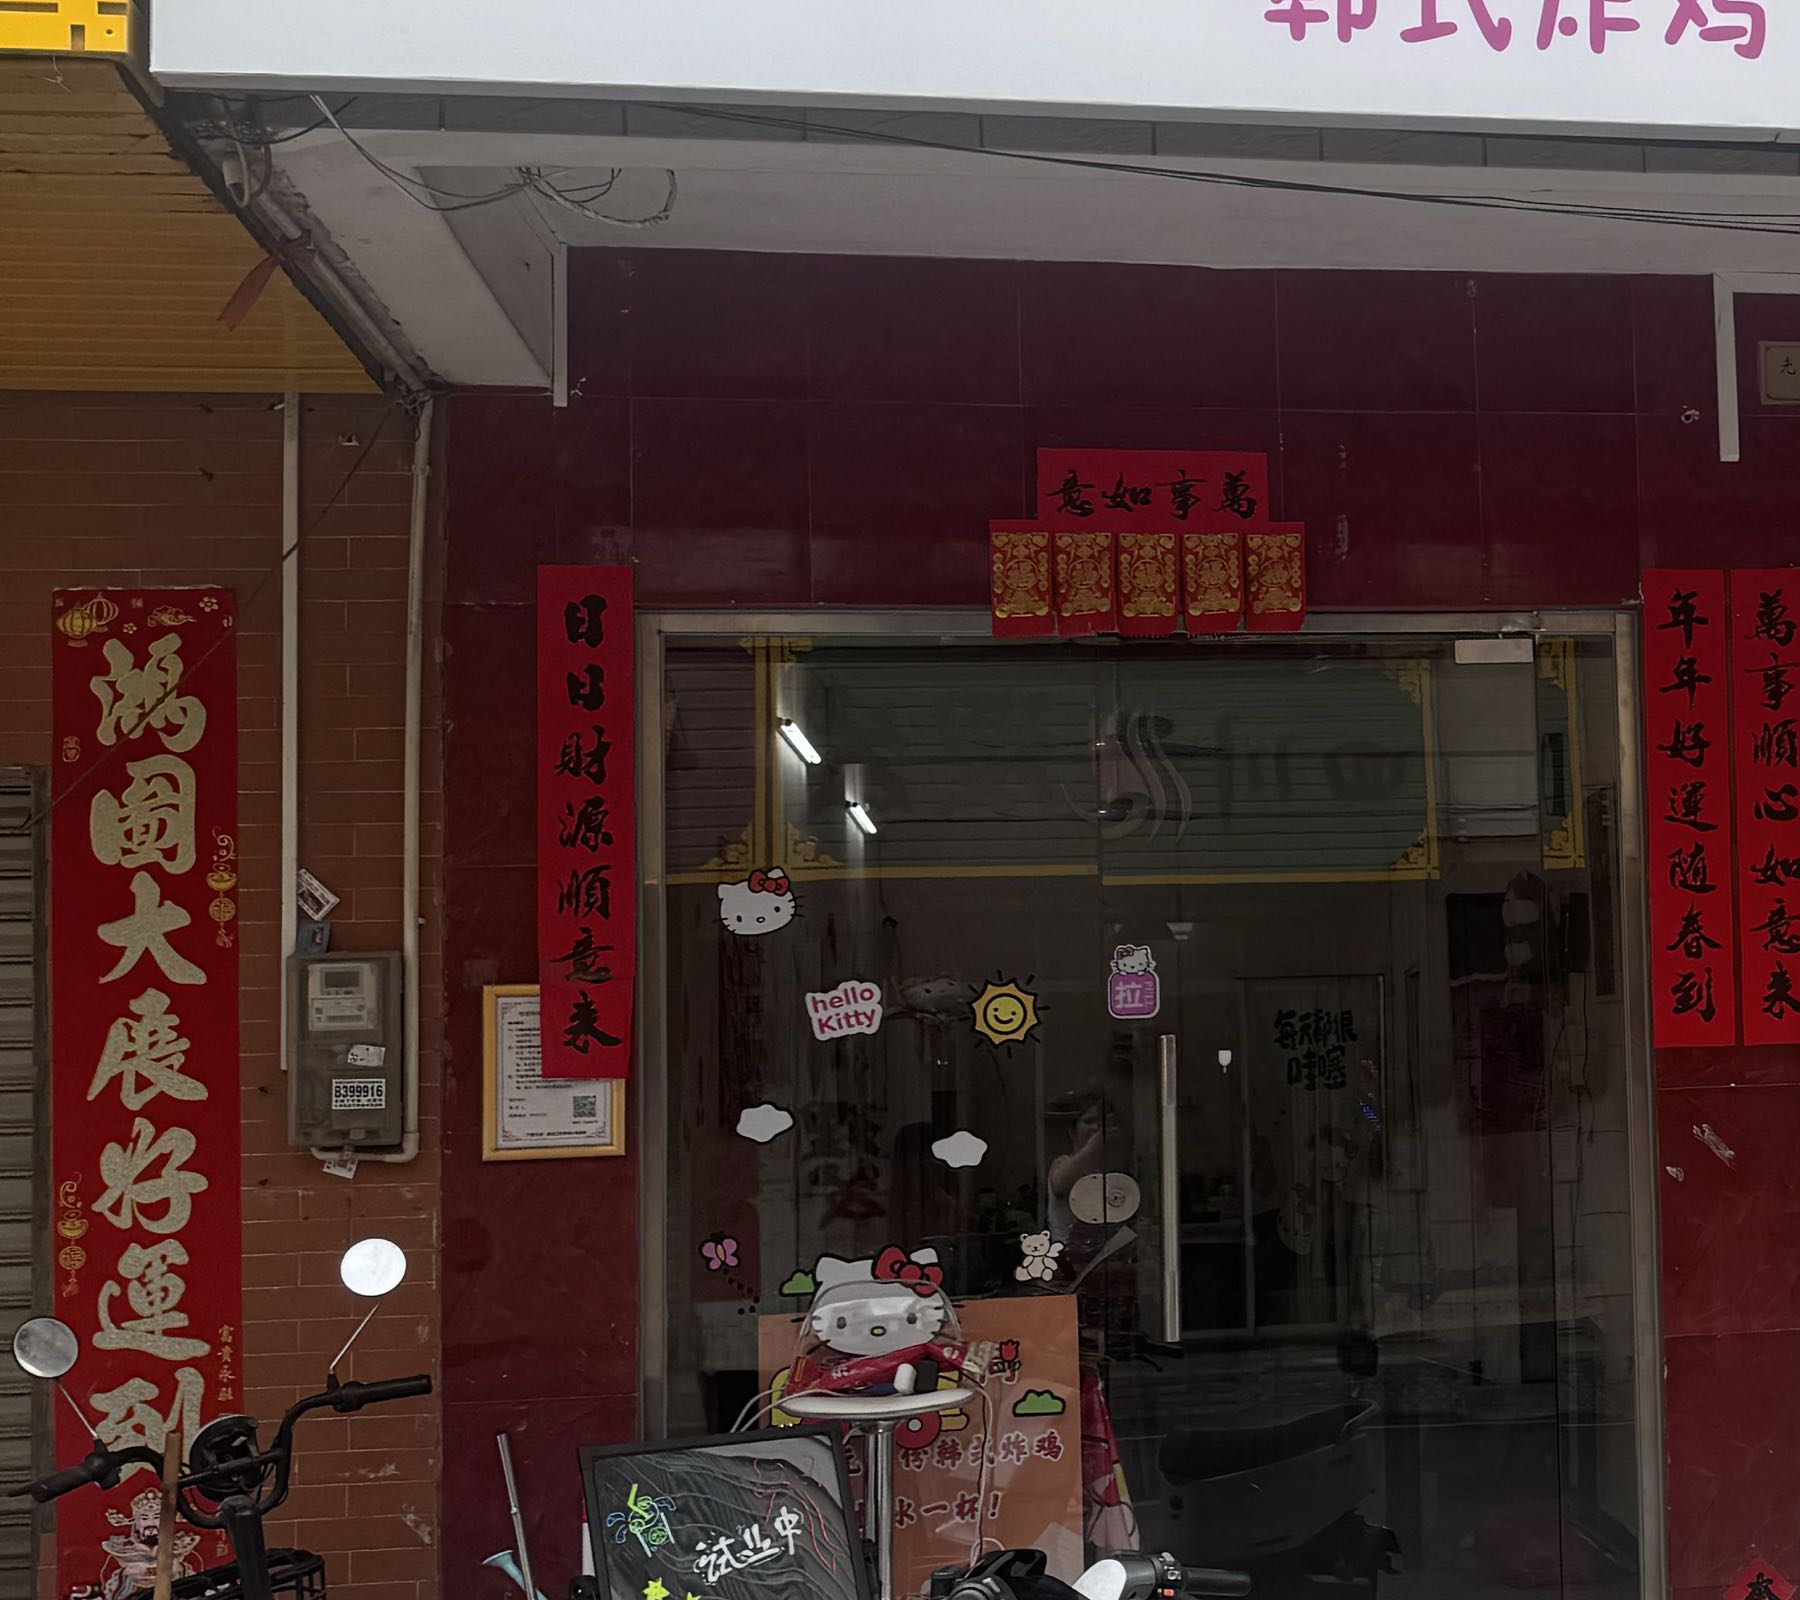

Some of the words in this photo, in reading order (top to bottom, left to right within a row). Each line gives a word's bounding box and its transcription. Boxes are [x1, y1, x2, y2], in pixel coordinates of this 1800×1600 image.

[811, 986, 874, 1013] hello
[1115, 980, 1144, 1009] 拉
[817, 1008, 876, 1035] Kitty
[855, 1490, 1001, 1528] 水一杯！
[693, 1506, 804, 1585] 试业中
